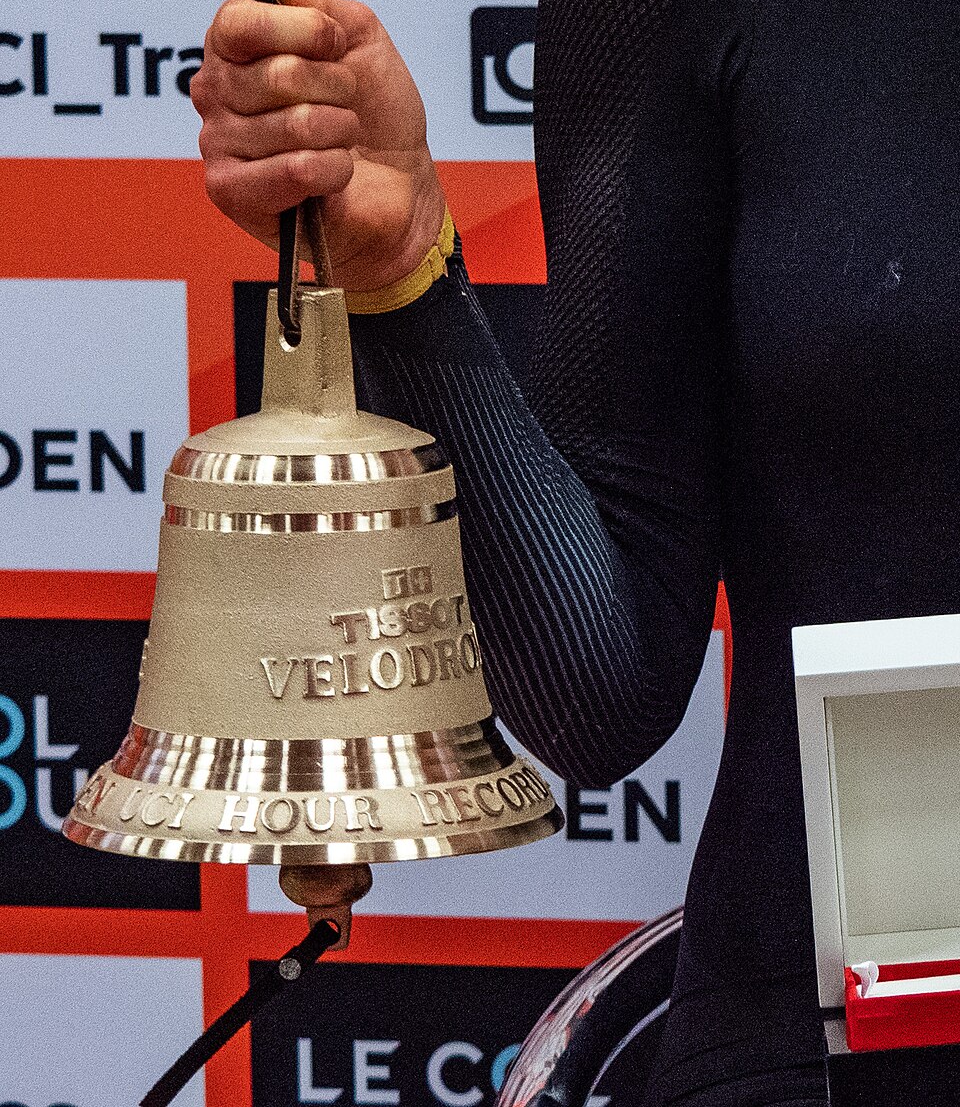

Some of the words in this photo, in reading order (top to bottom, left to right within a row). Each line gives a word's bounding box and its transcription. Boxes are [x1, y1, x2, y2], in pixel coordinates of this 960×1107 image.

[329, 593, 465, 644] TISSOT
[260, 626, 482, 699] VELODRO
[217, 793, 383, 833] HOUR
[297, 1037, 400, 1106] LE
